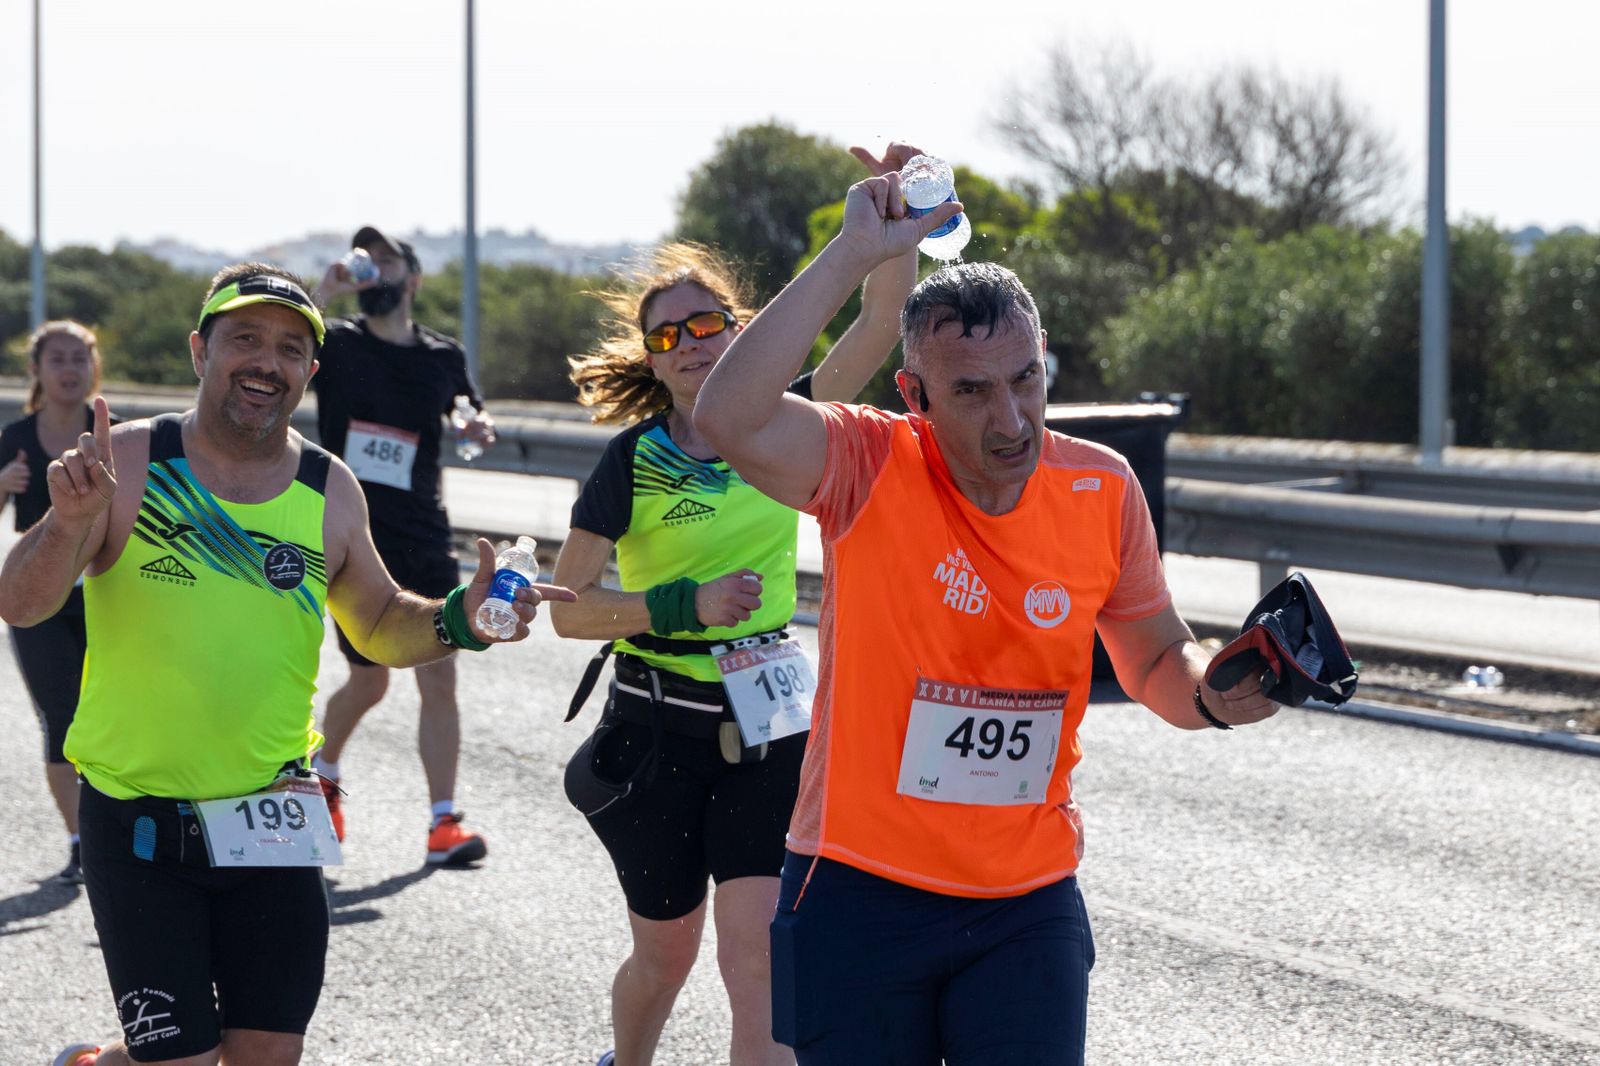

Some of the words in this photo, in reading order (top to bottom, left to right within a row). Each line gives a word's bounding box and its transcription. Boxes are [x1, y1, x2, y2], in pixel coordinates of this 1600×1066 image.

[362, 439, 404, 465] 486
[664, 512, 717, 527] ESMONSUR
[139, 571, 195, 587] ESMONSUR
[933, 563, 987, 595] MAD
[943, 587, 985, 615] RID
[754, 663, 806, 702] 198
[919, 682, 977, 704] XXXVI
[980, 690, 1017, 700] MEDIA
[944, 716, 1033, 761] 495
[969, 769, 999, 778] ANTONIO
[234, 797, 307, 831] 199
[147, 1035, 158, 1043] del
[161, 1027, 181, 1039] Canal
